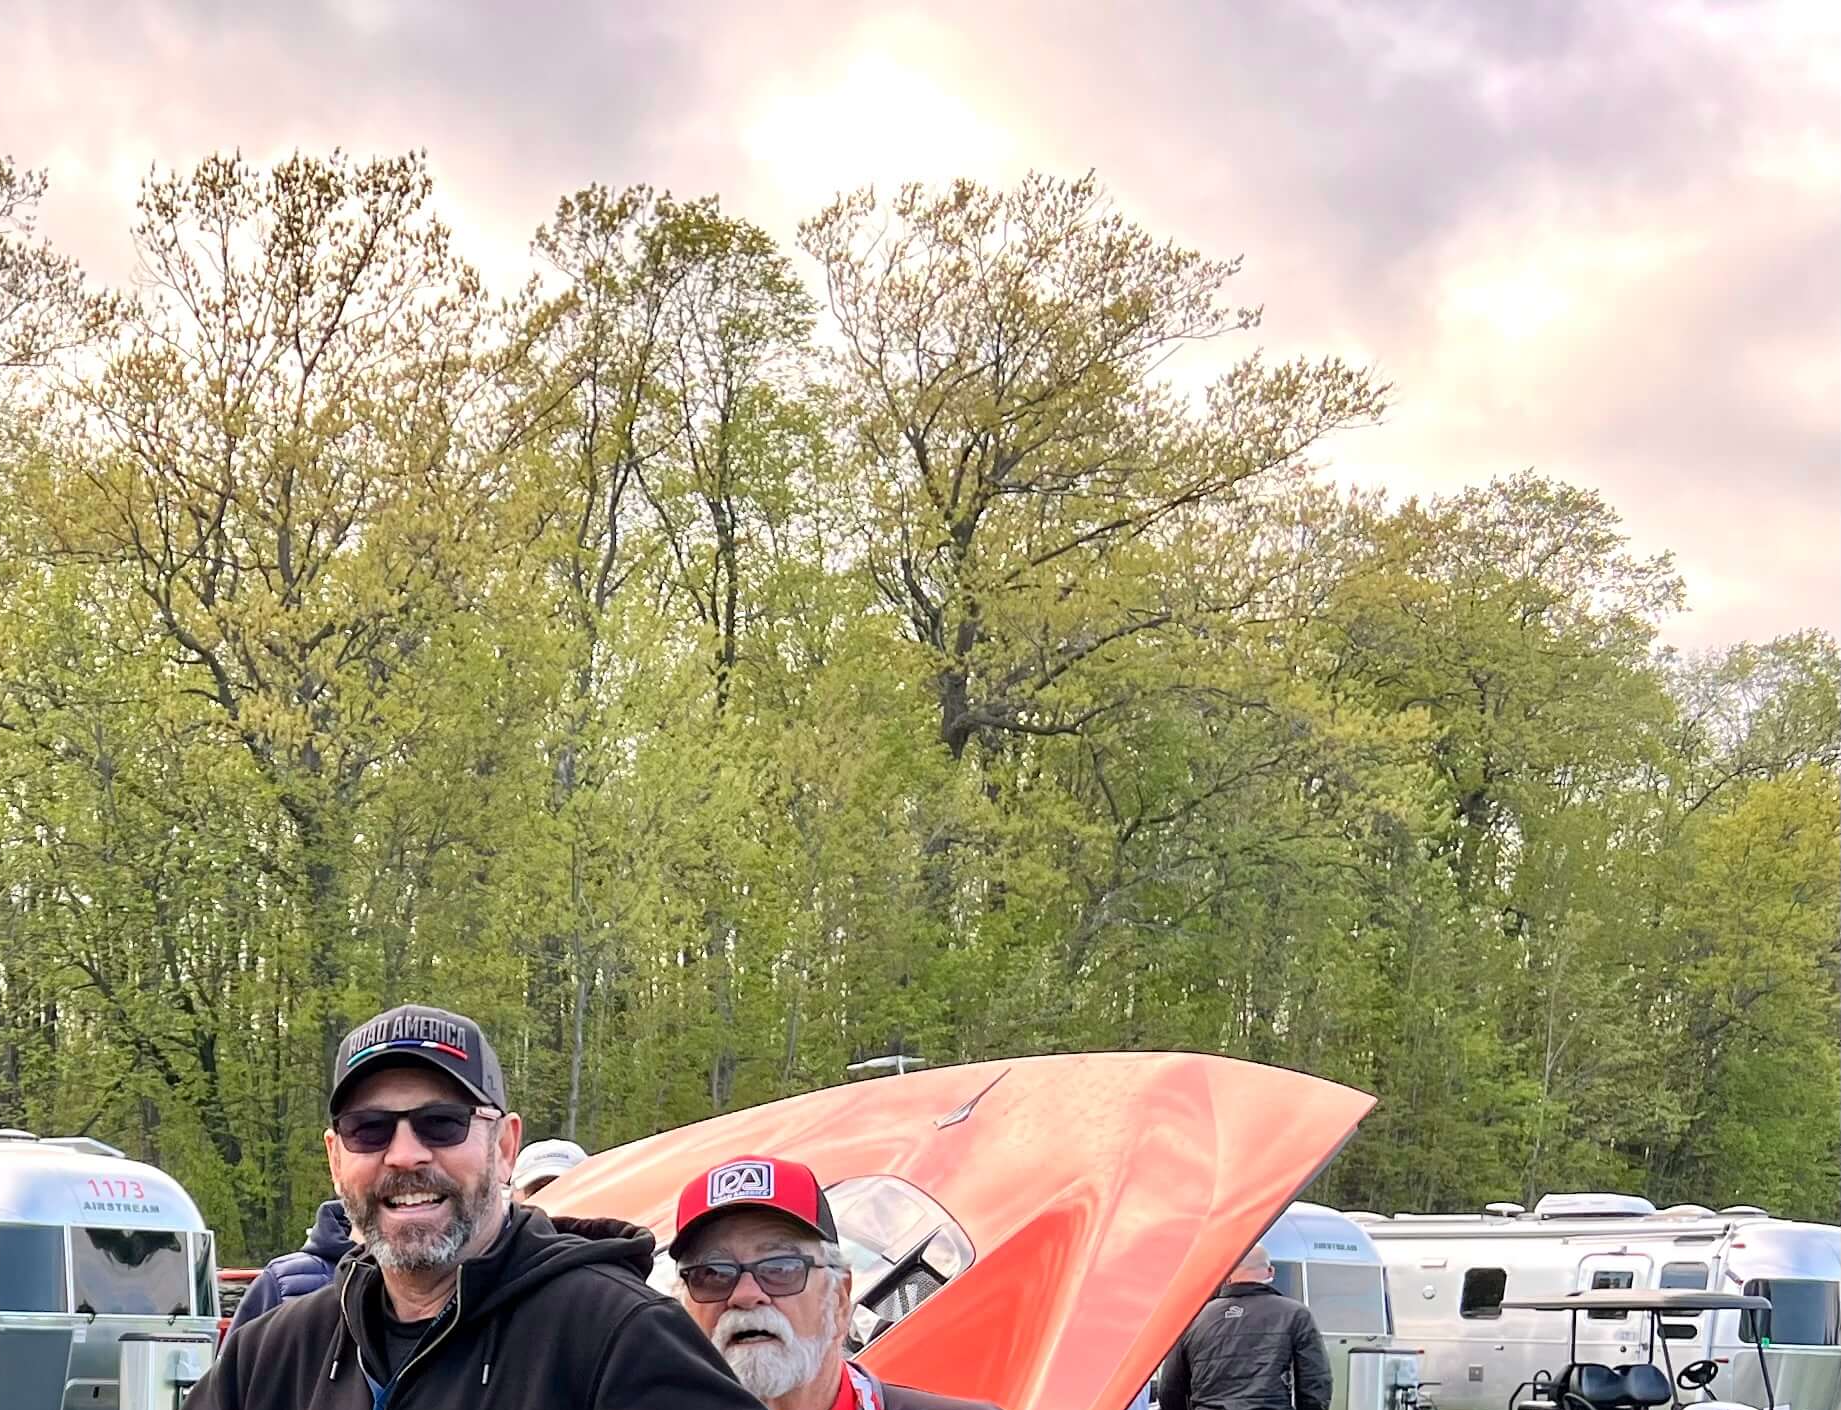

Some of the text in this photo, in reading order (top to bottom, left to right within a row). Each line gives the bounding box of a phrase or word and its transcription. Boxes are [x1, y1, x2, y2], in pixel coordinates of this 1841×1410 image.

[348, 1015, 467, 1055] ROAD AMERICA
[87, 1179, 145, 1199] 1173
[83, 1201, 160, 1214] AIRSTREAM
